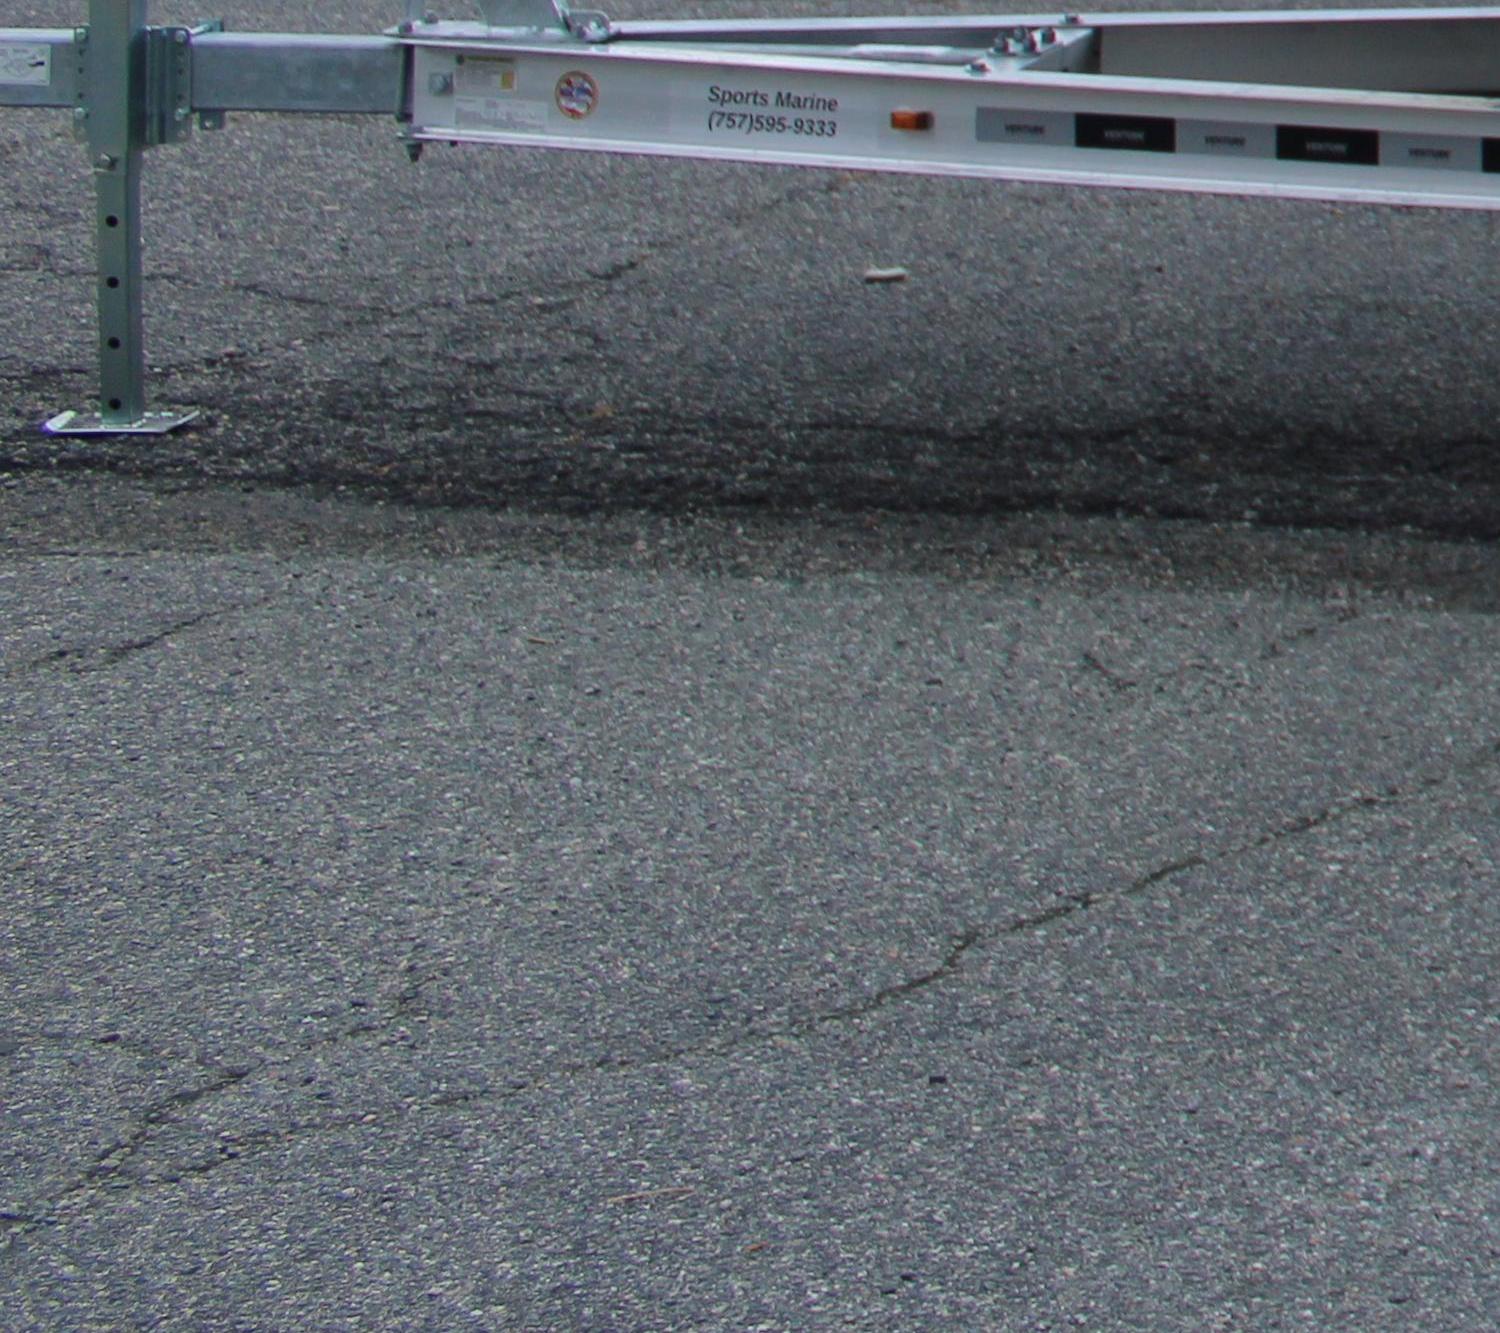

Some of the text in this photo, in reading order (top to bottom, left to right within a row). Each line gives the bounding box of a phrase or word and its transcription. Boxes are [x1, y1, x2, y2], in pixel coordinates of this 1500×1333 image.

[708, 85, 839, 112] Sports Marine
[708, 110, 837, 137] (757)595-9333
